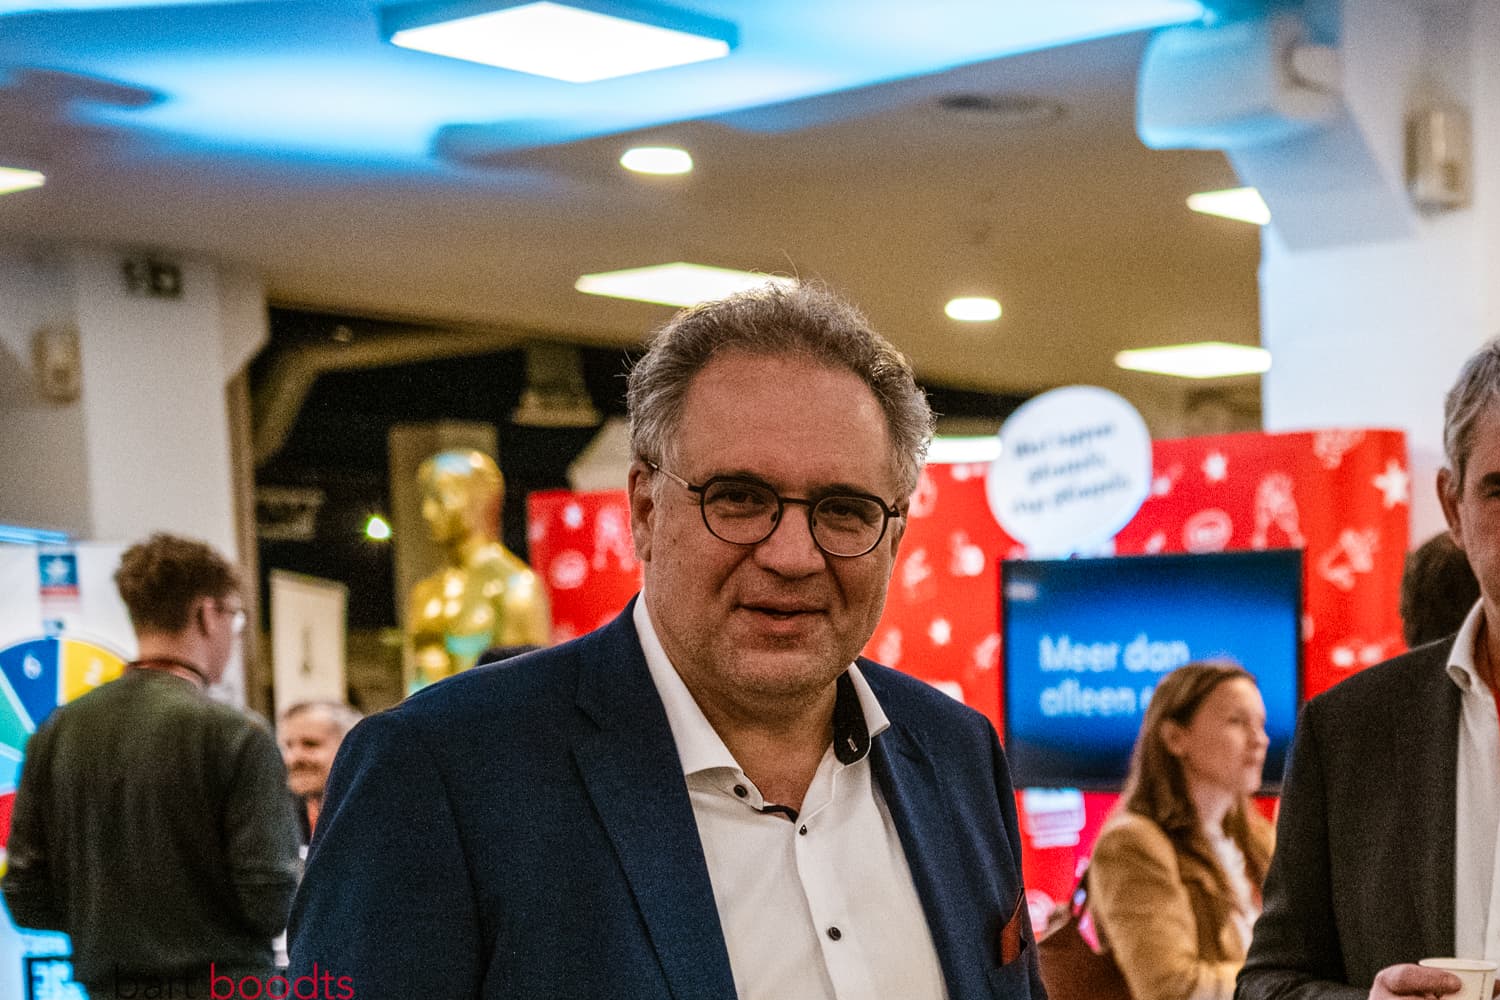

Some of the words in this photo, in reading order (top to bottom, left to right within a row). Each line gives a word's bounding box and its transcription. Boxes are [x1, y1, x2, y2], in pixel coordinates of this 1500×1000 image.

[1039, 634, 1119, 672] Meer
[1124, 632, 1191, 672] dan
[1039, 678, 1136, 716] alleen
